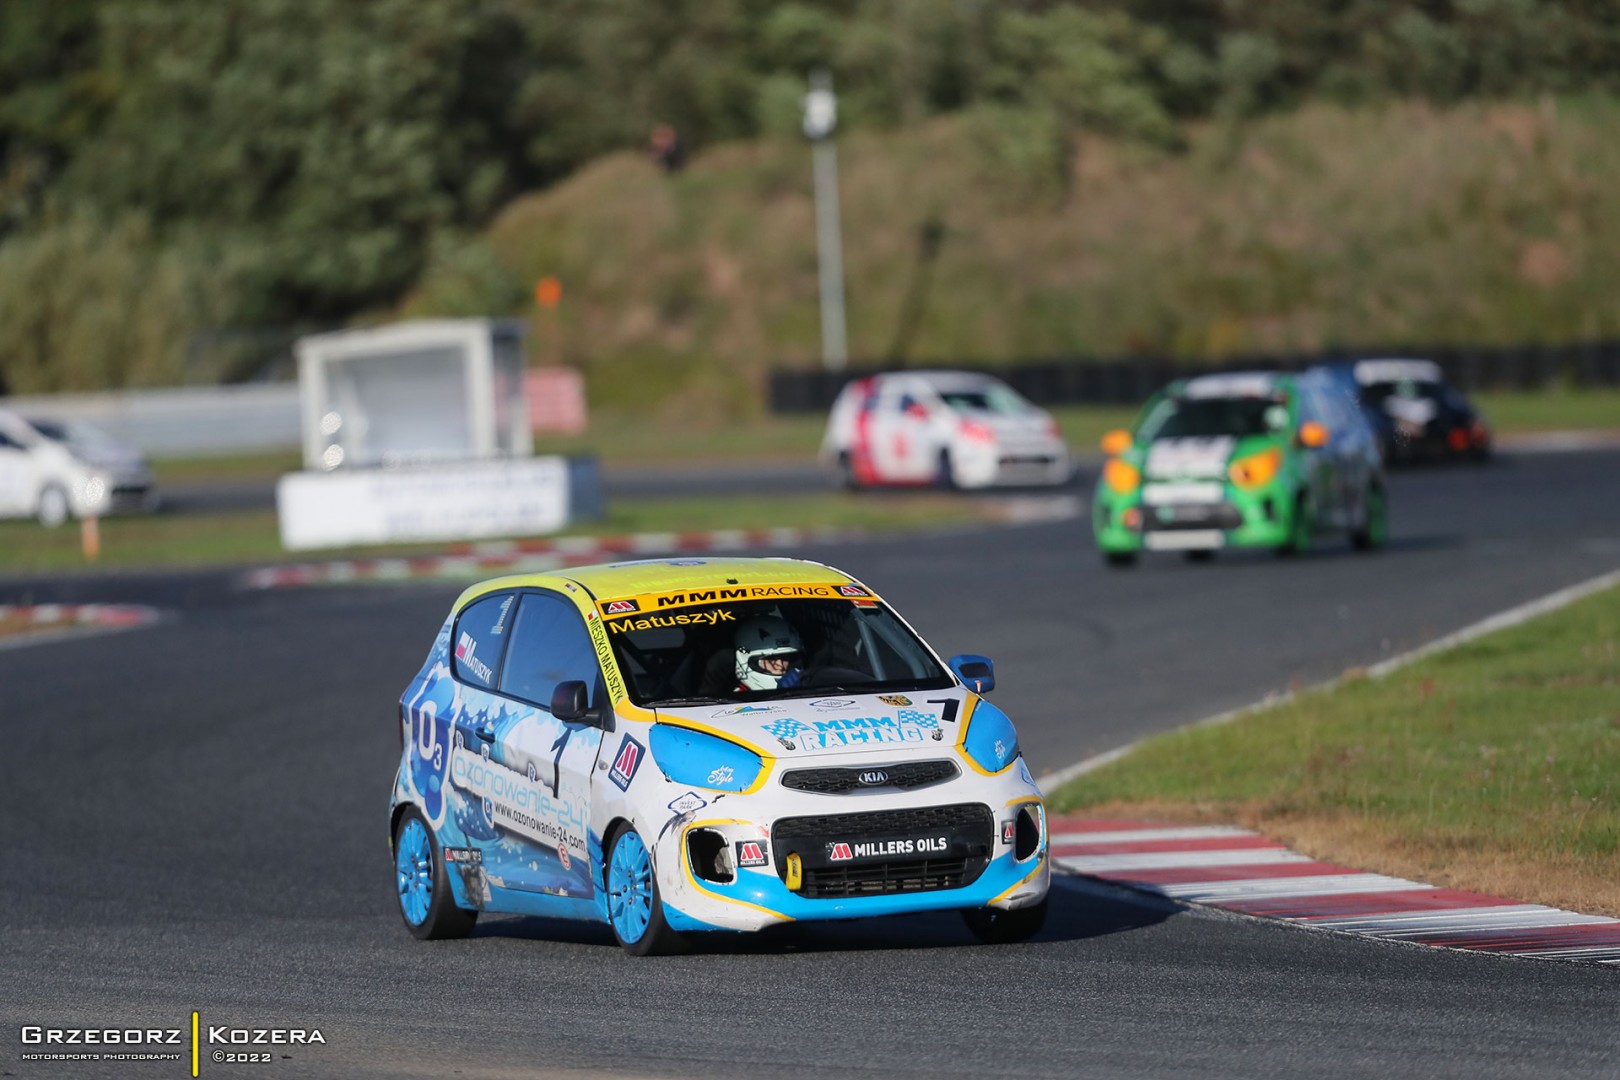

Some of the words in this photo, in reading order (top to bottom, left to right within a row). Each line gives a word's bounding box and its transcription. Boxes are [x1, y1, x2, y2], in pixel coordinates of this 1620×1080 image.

[658, 588, 747, 607] MMM
[751, 586, 829, 597] RACING
[609, 608, 736, 634] Matuszyk
[589, 616, 608, 655] MIESZKO
[601, 653, 624, 704] MATUSZYK
[926, 698, 960, 723] 1
[812, 716, 898, 733] MMM
[800, 726, 924, 752] RACING
[863, 772, 885, 782] KIA
[494, 801, 586, 852] www.ozonowanie-24.com
[854, 839, 914, 858] MILLERS
[917, 836, 947, 853] OILS
